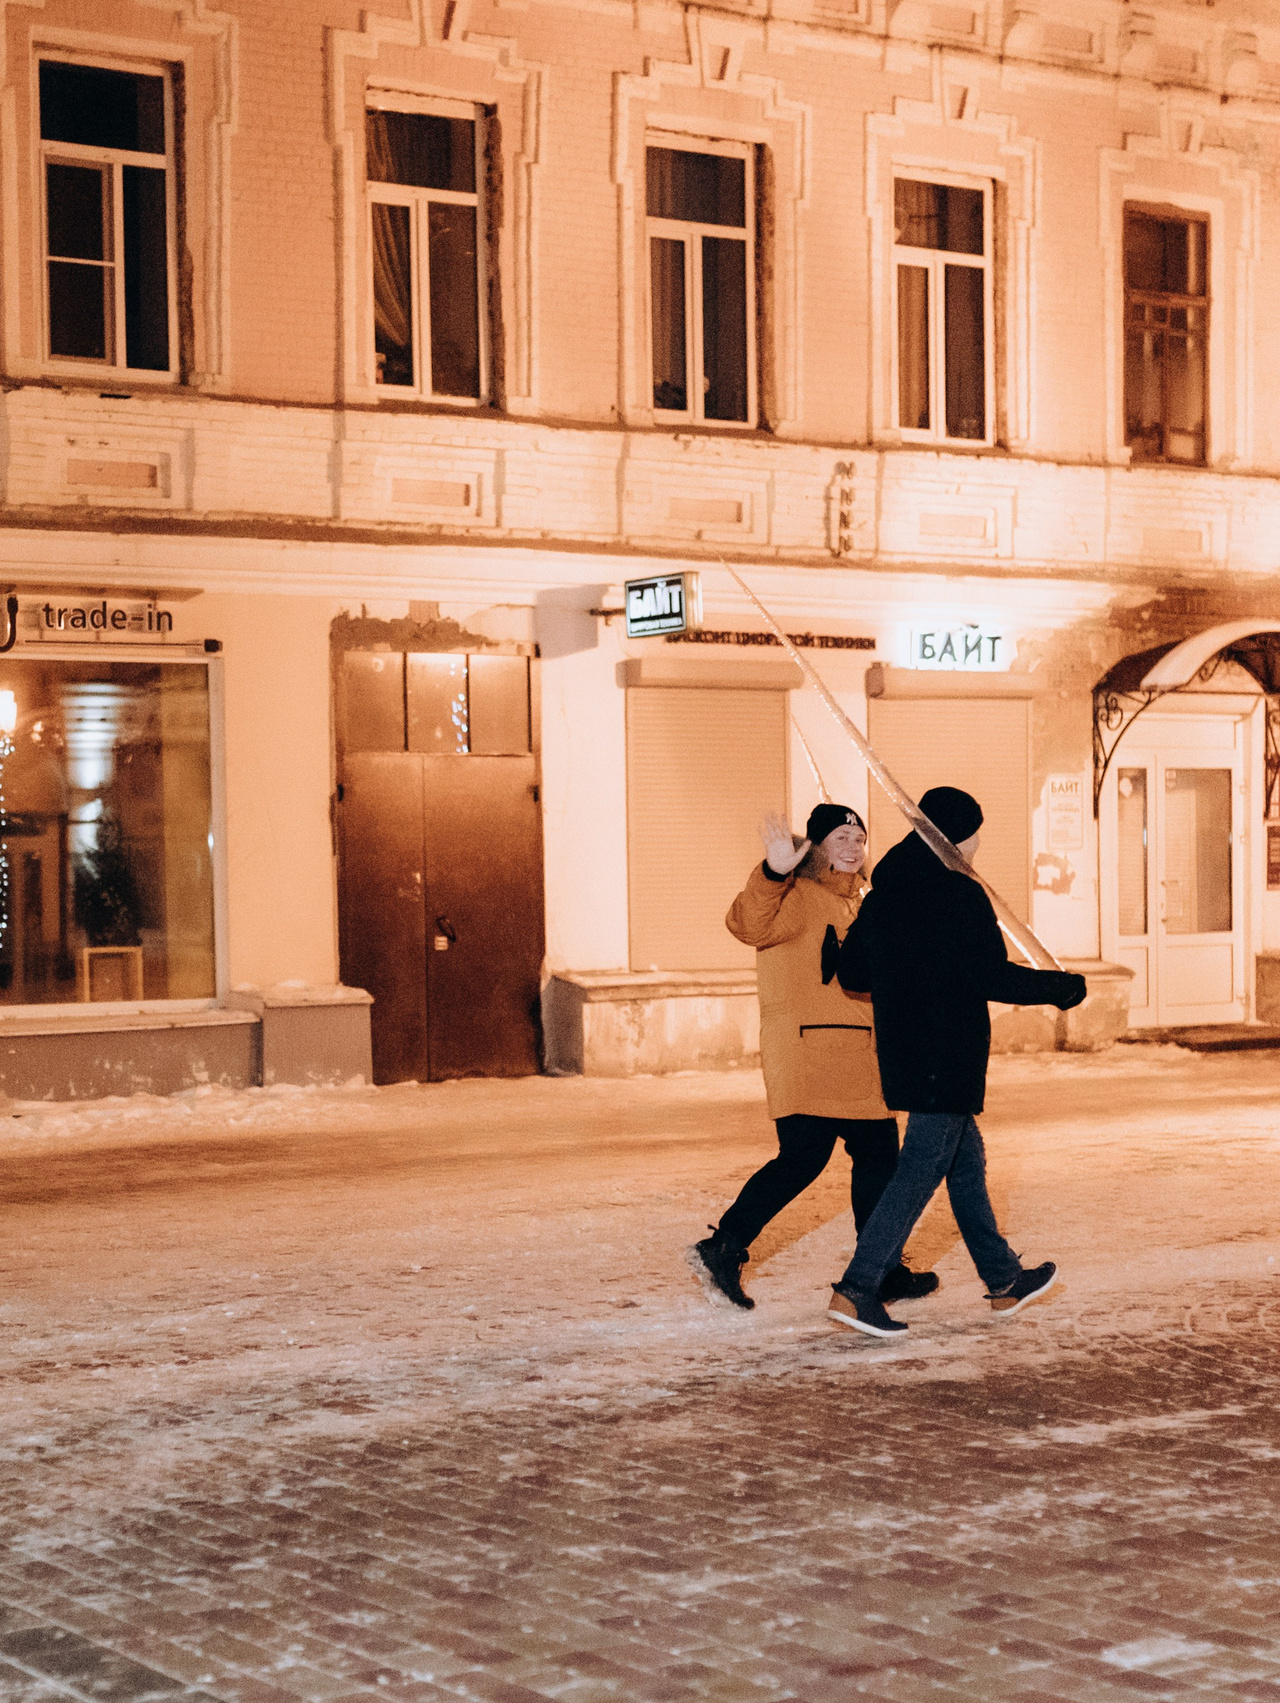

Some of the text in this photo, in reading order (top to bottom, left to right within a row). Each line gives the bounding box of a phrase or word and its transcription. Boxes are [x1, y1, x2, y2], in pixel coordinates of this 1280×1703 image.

[41, 601, 173, 632] trade-in
[629, 581, 682, 619] БАЙТ
[919, 624, 1002, 664] БАЙТ
